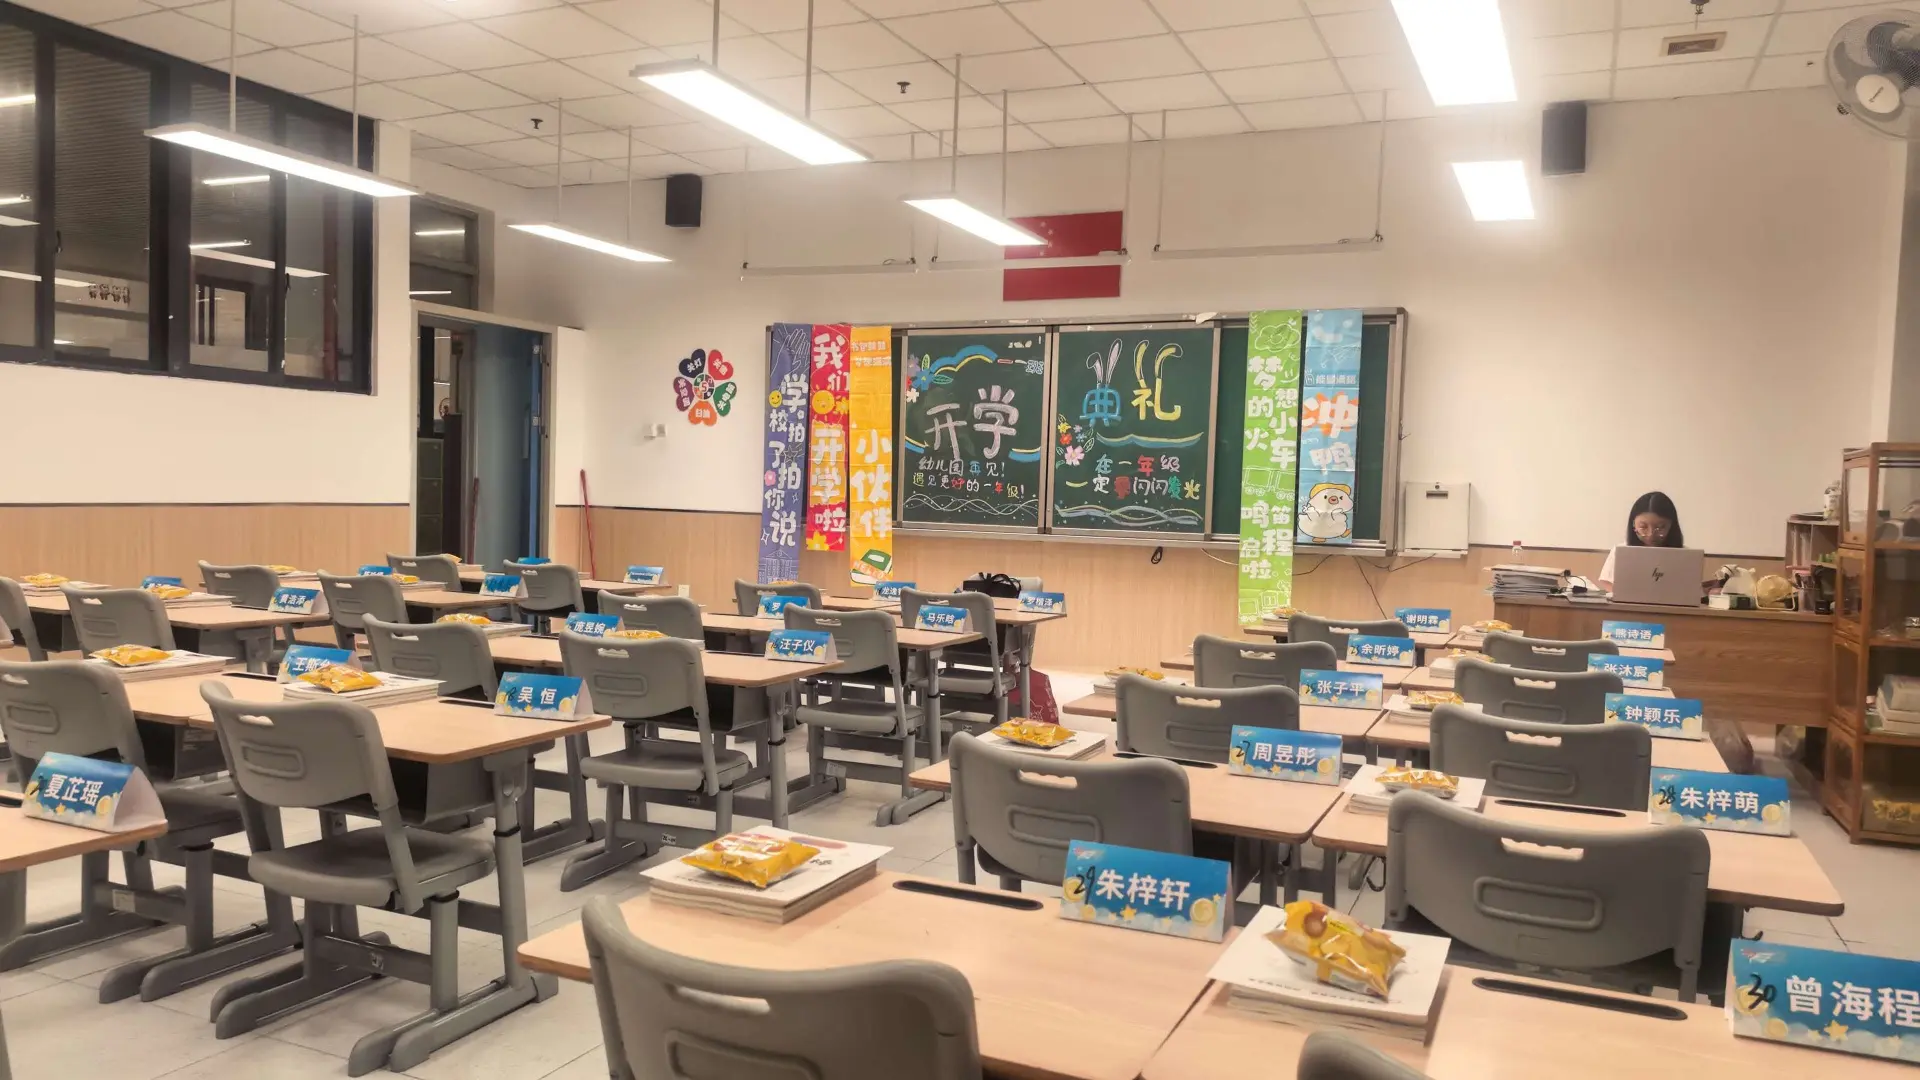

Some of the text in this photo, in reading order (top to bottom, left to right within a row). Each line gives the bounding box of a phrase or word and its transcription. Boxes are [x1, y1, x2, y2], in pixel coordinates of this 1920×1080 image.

[779, 638, 816, 652] 汪子仪
[1361, 643, 1400, 657] 余昕婷
[1317, 680, 1365, 697] 张子平
[1624, 705, 1681, 724] 钟颖乐
[1252, 742, 1317, 766] 周昱彤
[43, 773, 104, 807] 夏芷瑶
[1680, 787, 1759, 814] 朱梓萌
[1096, 868, 1191, 911] 朱梓轩
[1786, 974, 1920, 1028] 曾海程
